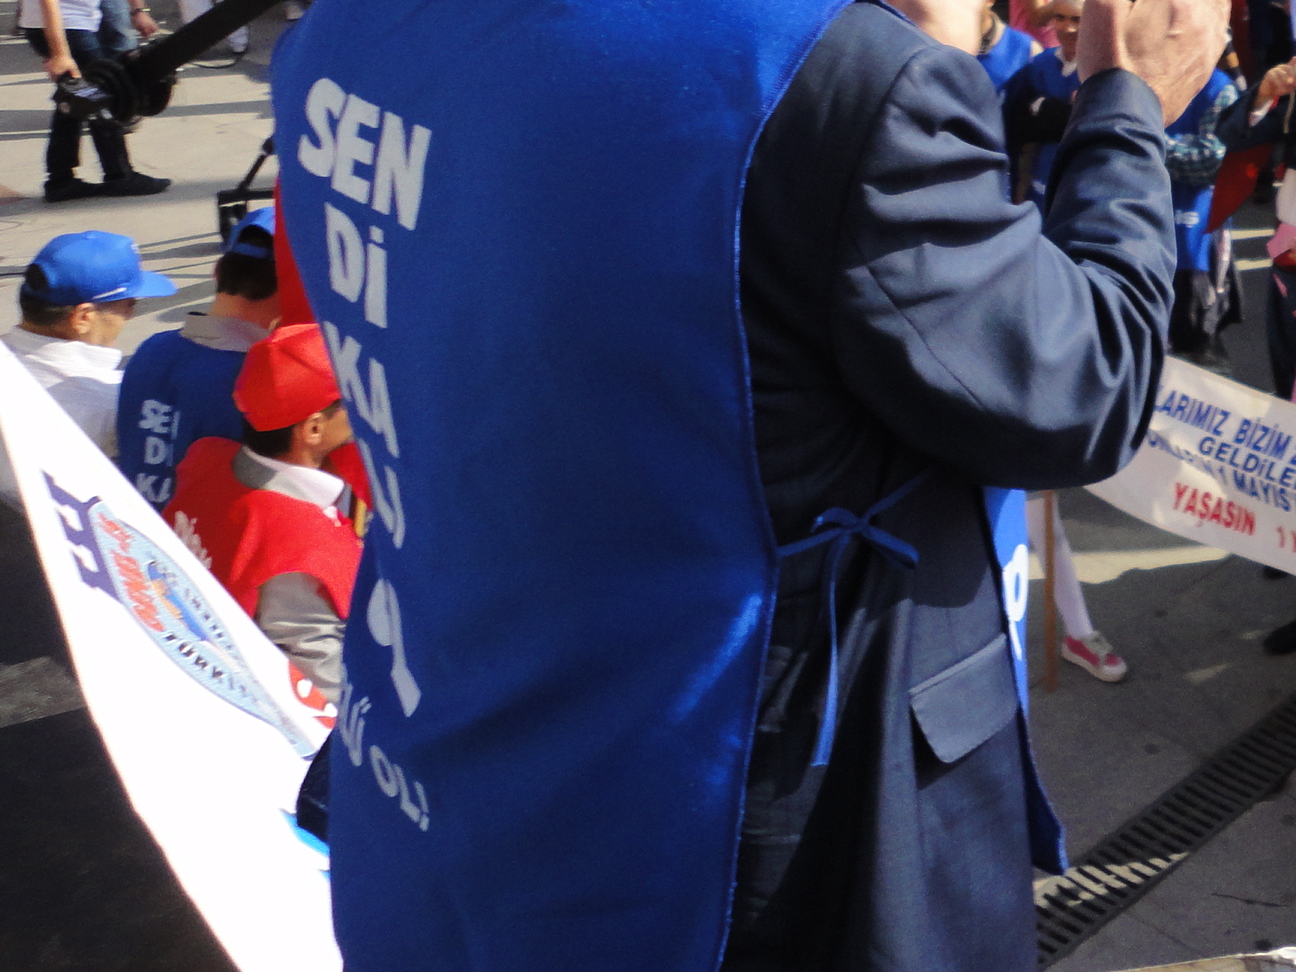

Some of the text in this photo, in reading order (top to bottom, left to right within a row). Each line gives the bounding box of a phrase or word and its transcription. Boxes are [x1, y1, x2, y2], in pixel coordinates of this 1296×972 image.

[297, 77, 432, 231] SEN
[1233, 417, 1293, 461] BİZİM
[1173, 482, 1256, 539] YAŞASIN
[1277, 526, 1286, 549] 1
